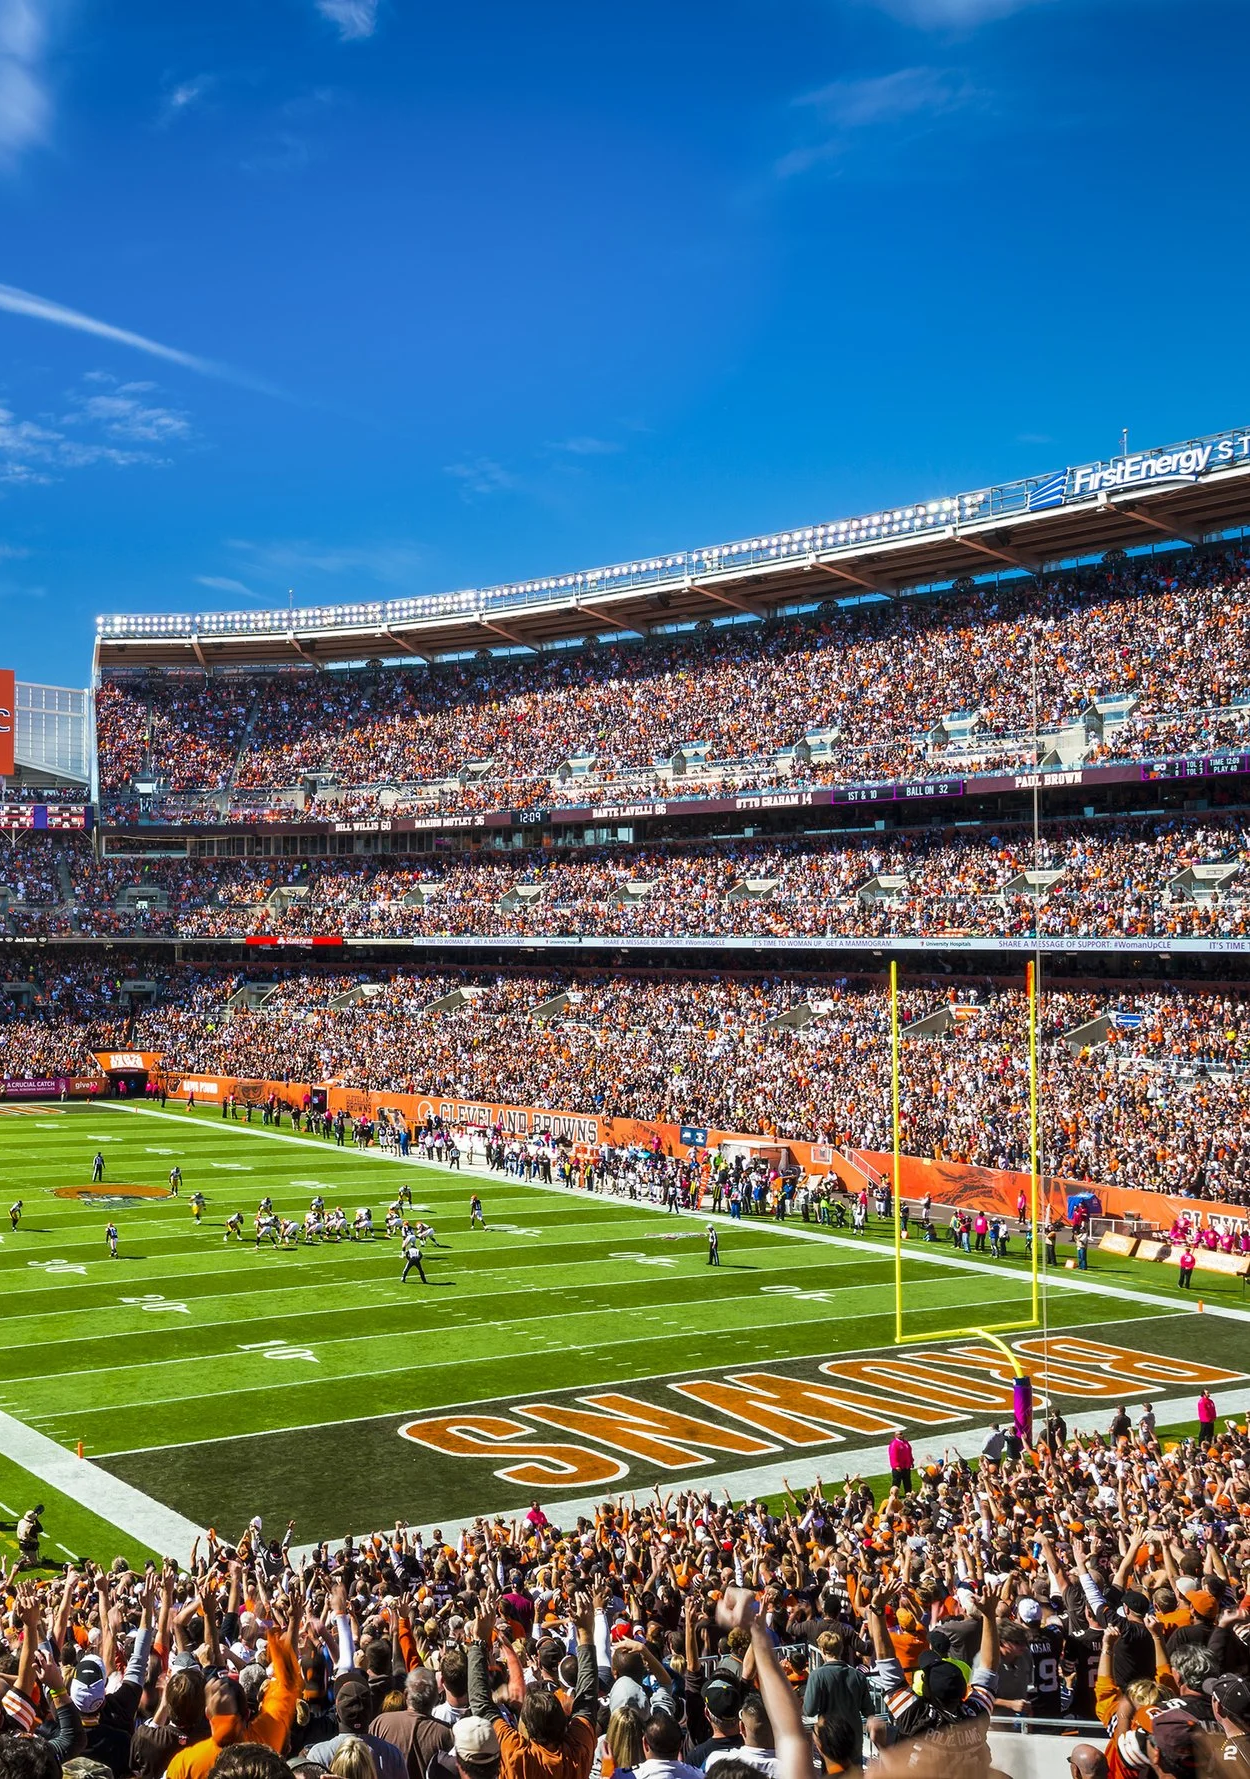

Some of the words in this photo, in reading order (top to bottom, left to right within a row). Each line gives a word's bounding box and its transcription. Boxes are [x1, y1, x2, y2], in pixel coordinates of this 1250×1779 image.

[1073, 444, 1214, 495] FirstEnergy
[1014, 774, 1042, 788] PAUL
[1043, 771, 1083, 786] BROWN
[847, 791, 859, 800] 1ST
[870, 790, 877, 799] 10
[906, 786, 924, 796] BALL
[924, 785, 934, 794] ON
[939, 784, 948, 794] 32
[736, 797, 761, 809] OTTO
[762, 795, 798, 808] GRAHAM
[801, 792, 812, 805] 14
[519, 812, 541, 823] 12:09
[592, 808, 619, 818] DANTE
[620, 805, 652, 817] LAVELLI
[655, 804, 667, 815] 86
[335, 823, 353, 832] BILL
[353, 822, 379, 832] WILLIS
[381, 821, 391, 831] 60
[414, 819, 441, 829] MARION
[442, 817, 472, 828] MOTLEY
[474, 816, 485, 826] 36
[998, 940, 1022, 948] SHARE
[1030, 940, 1064, 948] MESSAGE
[1077, 940, 1112, 948] SUPPORT:
[1113, 940, 1171, 948] #WomanUpCLE
[1209, 942, 1224, 950] IT'S
[1225, 942, 1244, 950] TIME
[346, 1101, 372, 1113] BROWNS
[439, 1102, 527, 1134] CLEVELAND
[533, 1114, 598, 1146] BROWNS
[26, 1258, 88, 1276] 30
[117, 1294, 192, 1315] 20
[236, 1339, 321, 1363] 10
[396, 1335, 1250, 1488] BROWNS
[1223, 1746, 1238, 1761] 2
